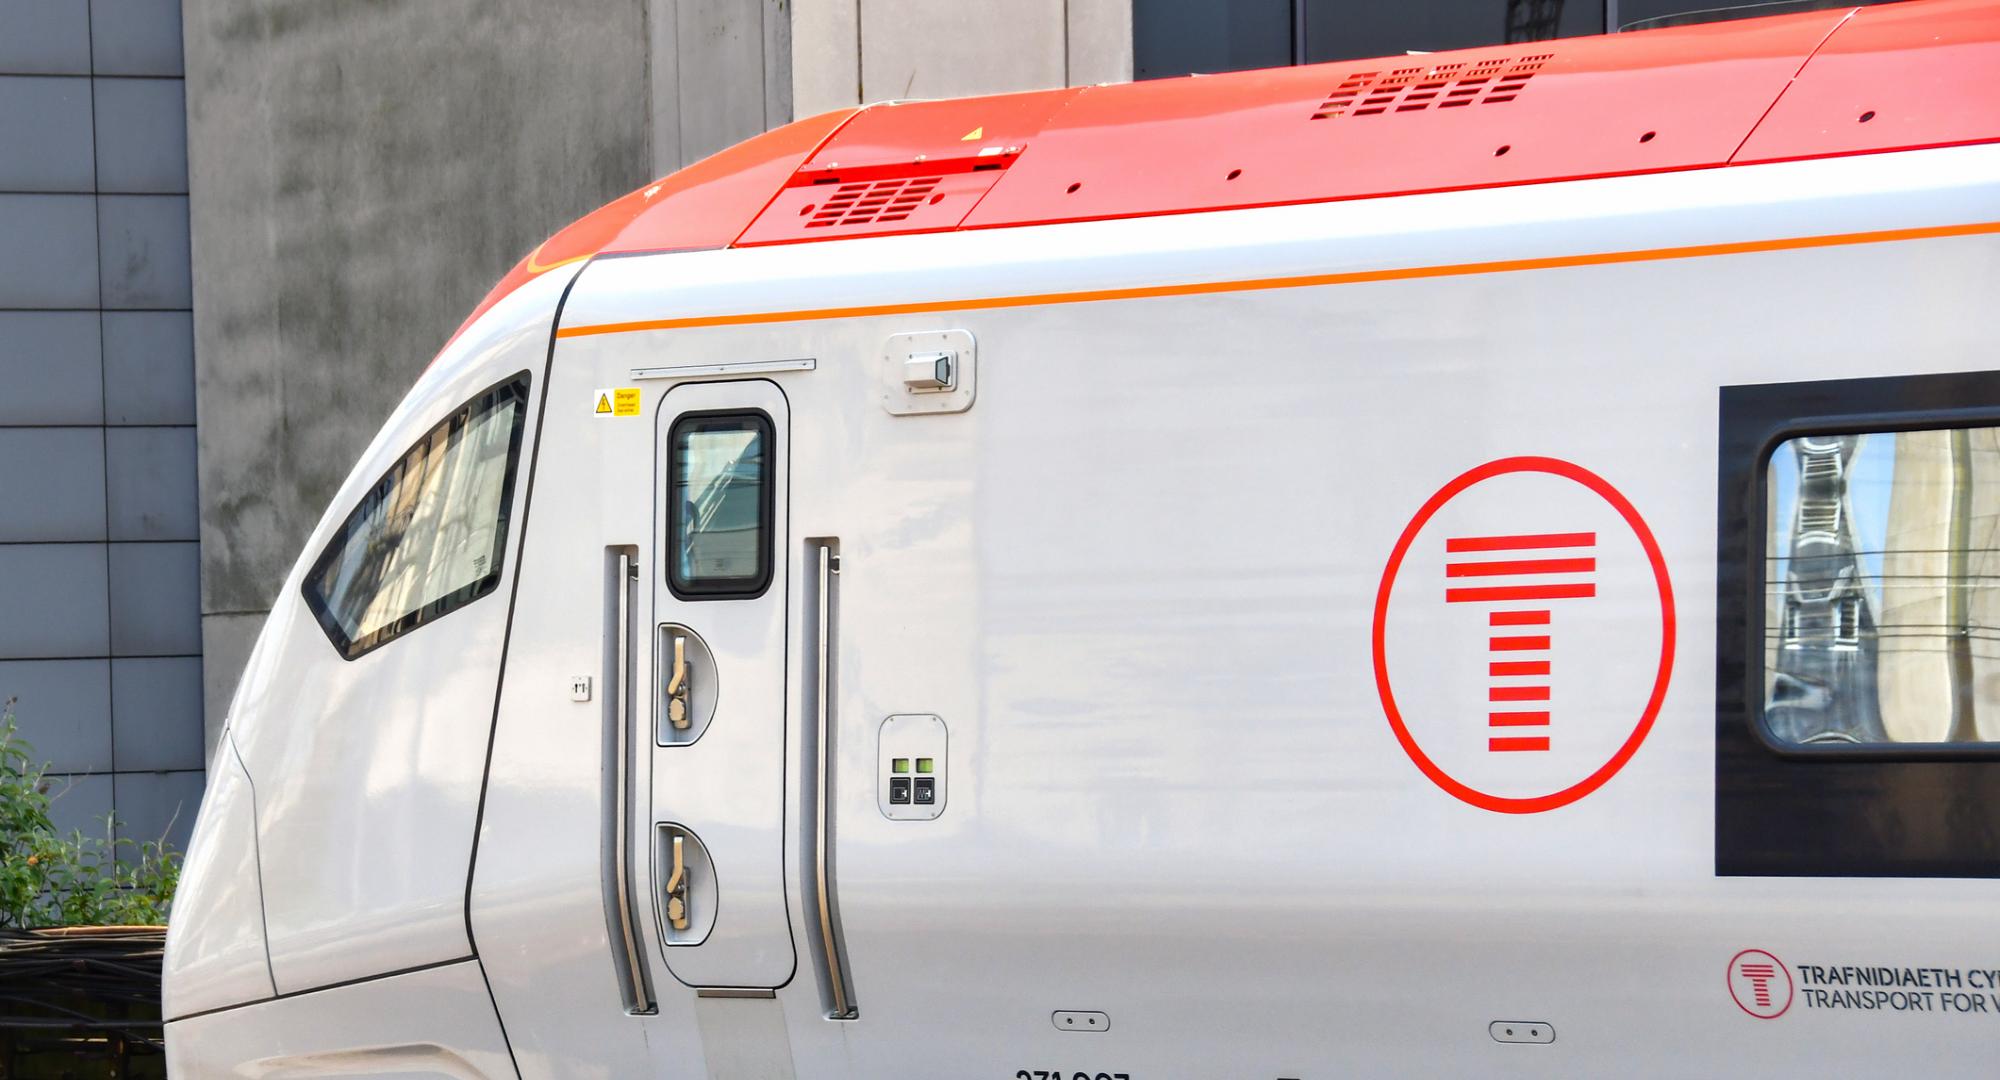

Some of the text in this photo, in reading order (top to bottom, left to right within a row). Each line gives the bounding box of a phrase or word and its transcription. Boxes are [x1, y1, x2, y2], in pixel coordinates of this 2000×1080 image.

[1446, 532, 1596, 752] T
[1740, 964, 1775, 1007] T
[1797, 965, 2000, 989] TRAFNIDIAETH CY
[1801, 988, 1934, 1011] TRANSPORT
[1940, 992, 1988, 1013] FOR
